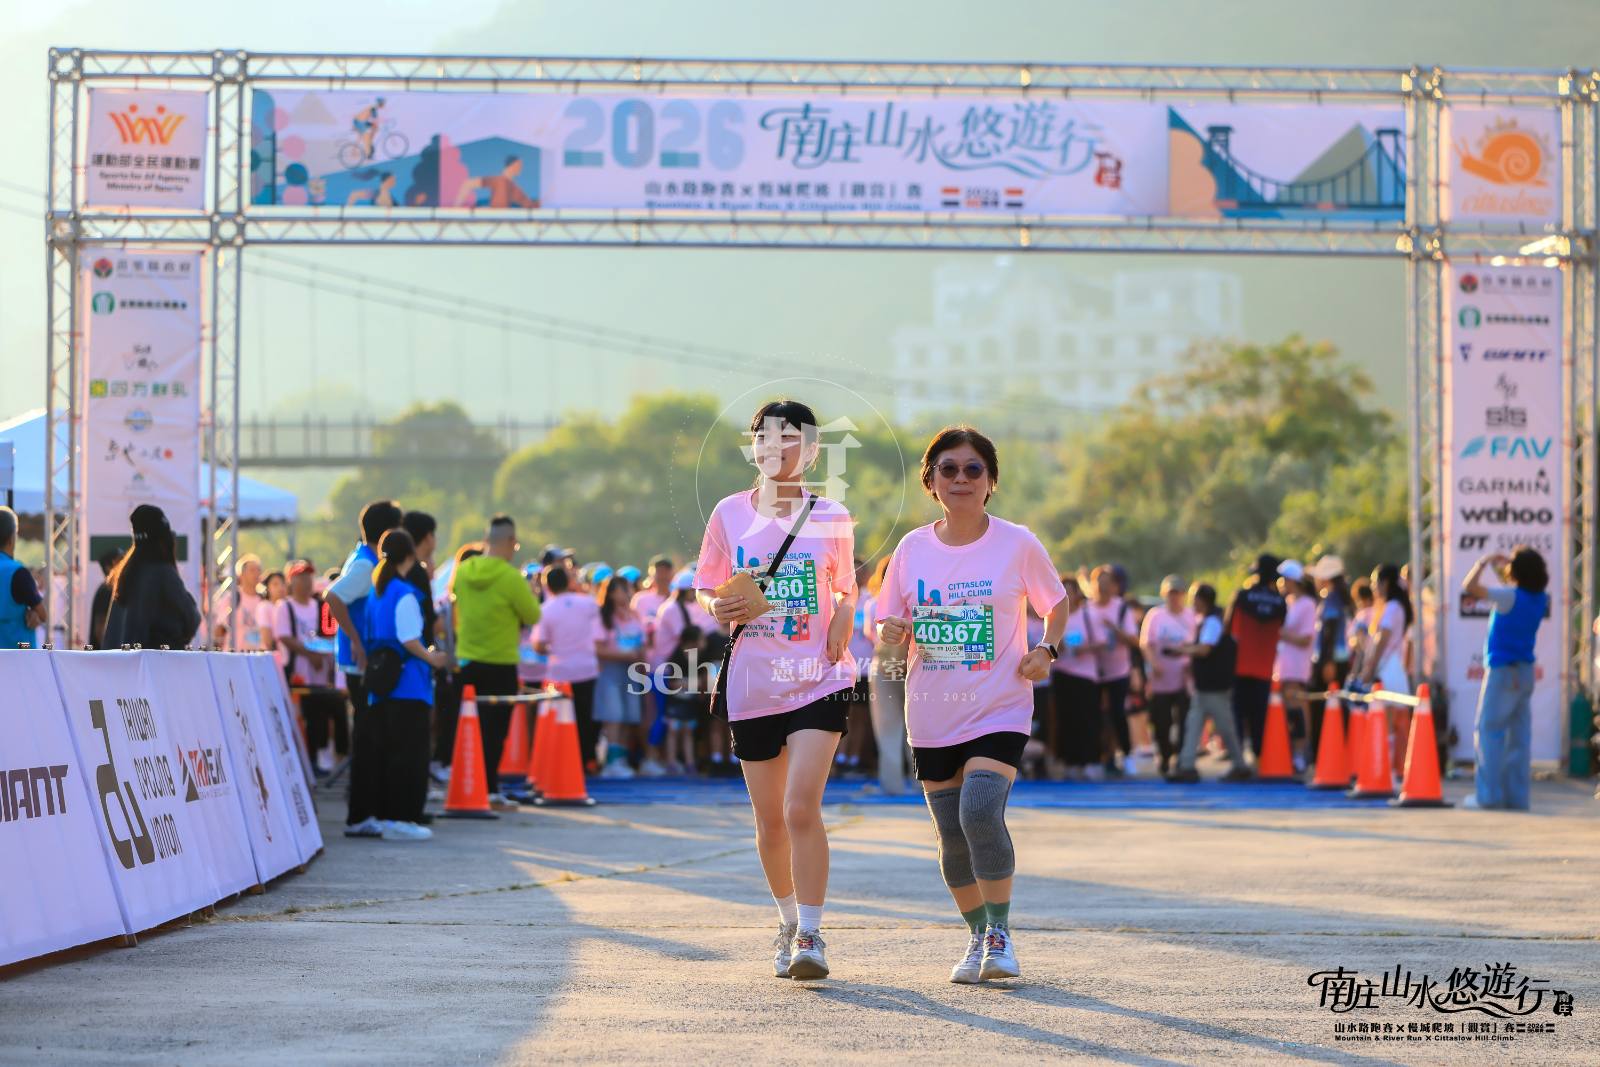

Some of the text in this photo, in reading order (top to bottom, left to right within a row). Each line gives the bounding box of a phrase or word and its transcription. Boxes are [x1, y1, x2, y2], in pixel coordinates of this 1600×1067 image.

[563, 98, 745, 171] 2026
[759, 100, 1103, 180] 南庄山水悠遊行
[1459, 477, 1550, 495] GARMIN
[1460, 499, 1552, 525] wahoo
[1460, 535, 1489, 550] DT
[764, 579, 804, 599] 460
[948, 580, 992, 591] CITTASLOW
[948, 589, 992, 600] HILL CLIMB
[915, 623, 983, 643] 40367
[0, 764, 69, 824] IANT
